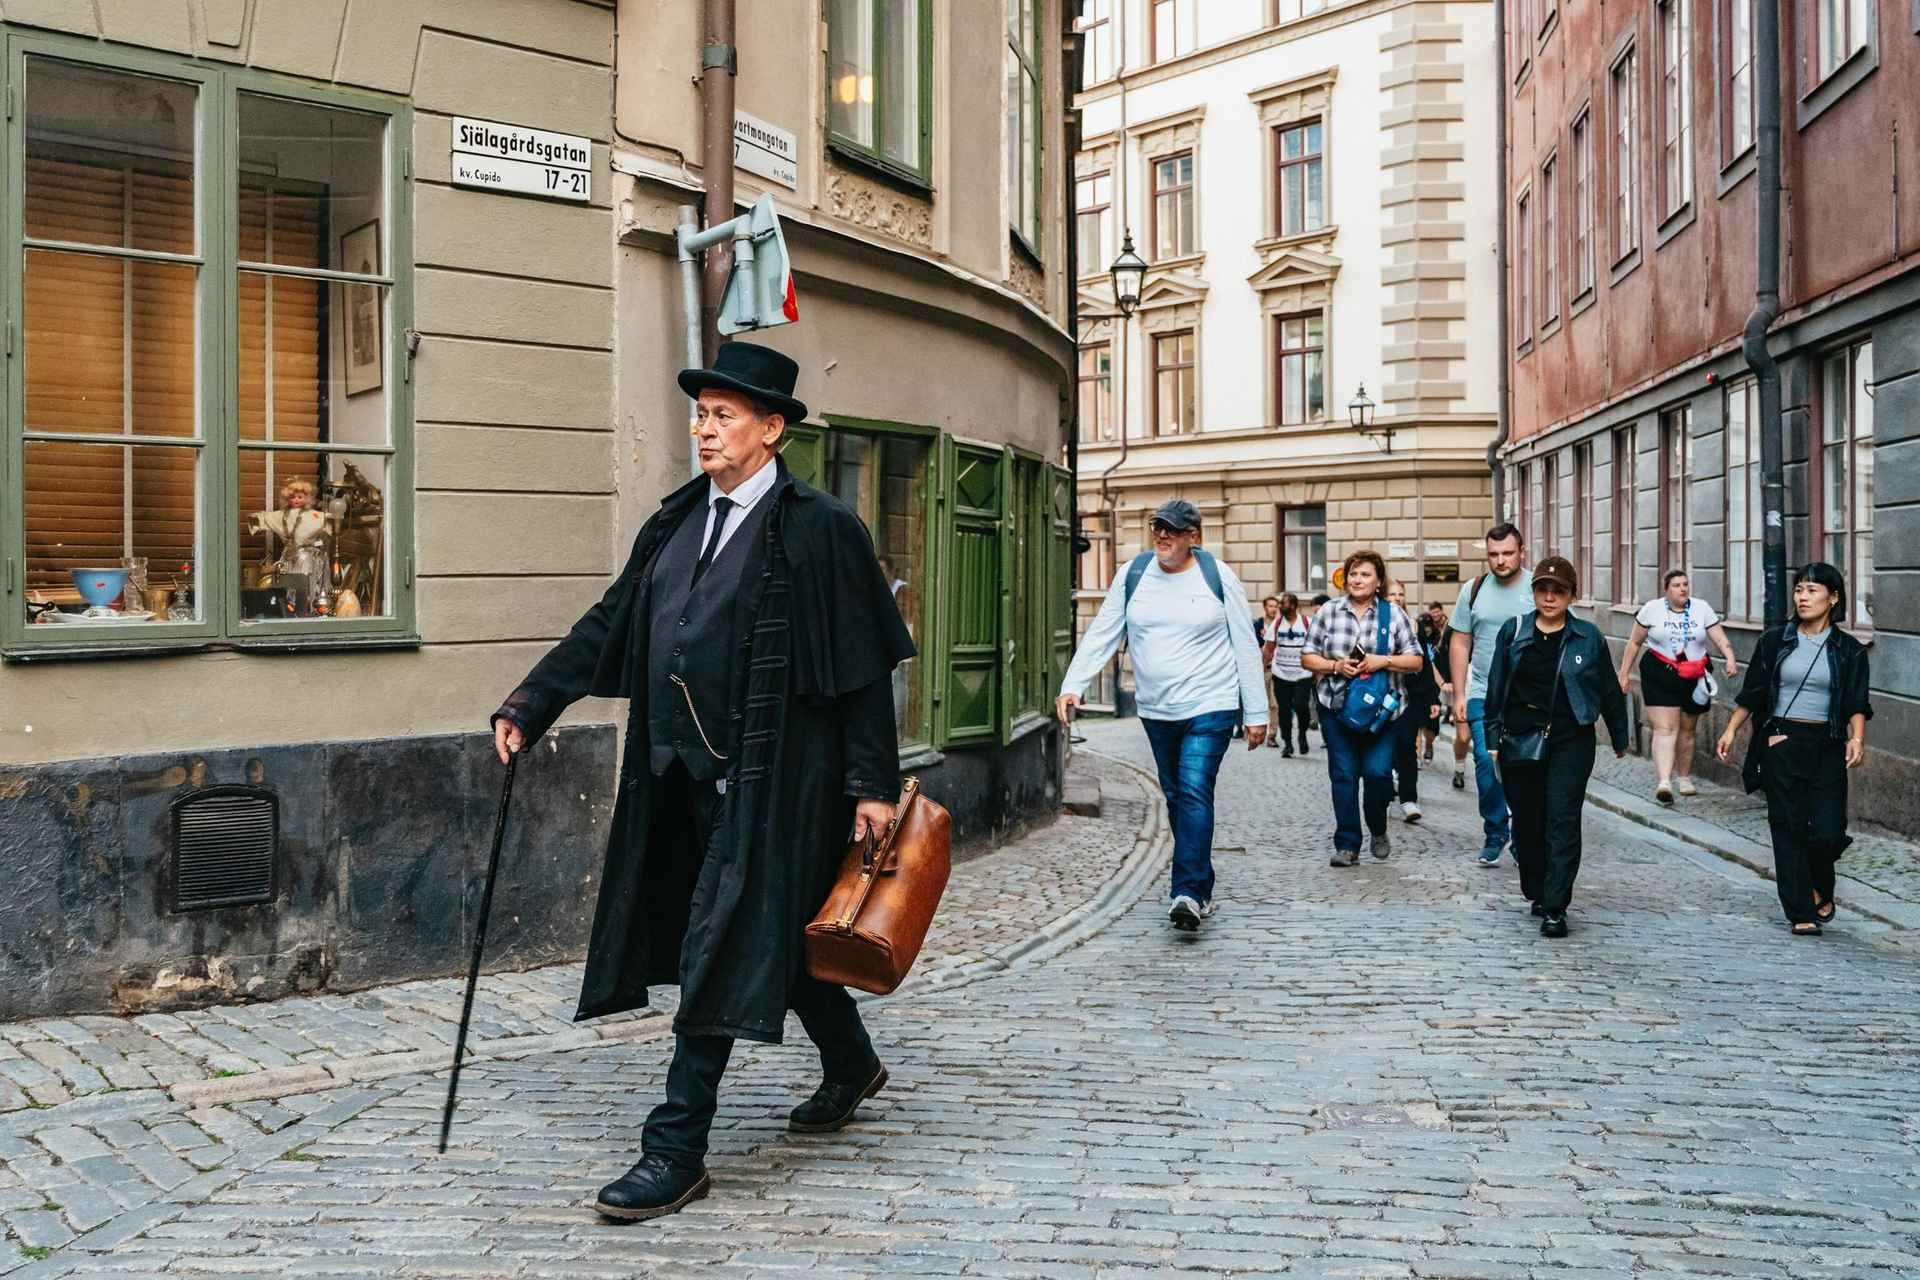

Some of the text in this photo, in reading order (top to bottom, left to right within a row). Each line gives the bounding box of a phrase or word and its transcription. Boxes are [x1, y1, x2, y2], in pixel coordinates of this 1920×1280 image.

[460, 125, 586, 163] Själagårdsgatan
[460, 167, 502, 183] kv. Cupido
[545, 169, 586, 194] 17-21
